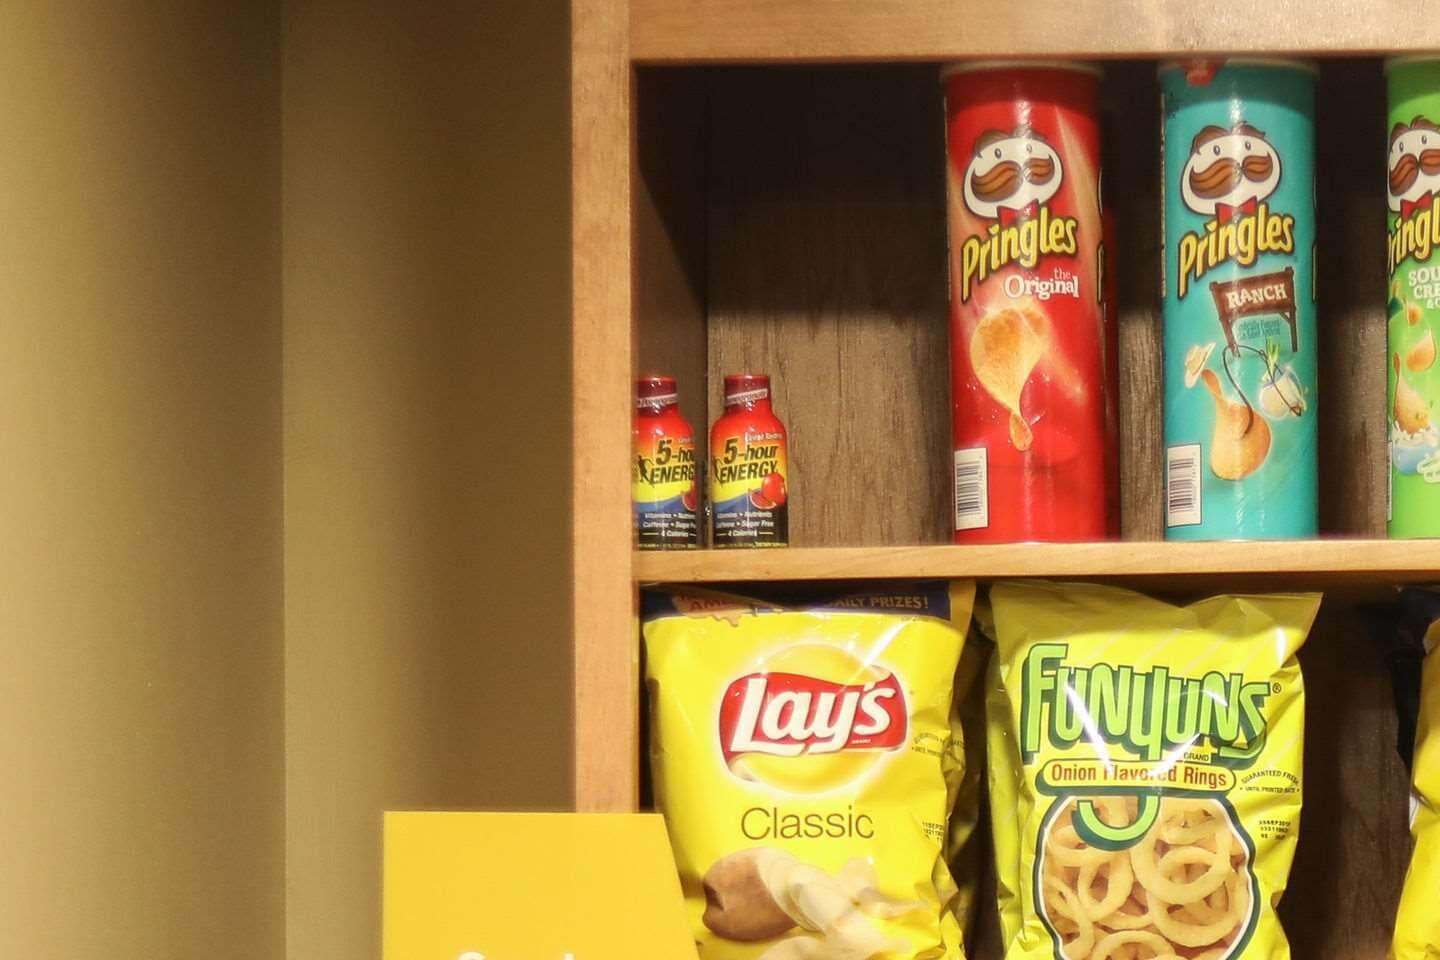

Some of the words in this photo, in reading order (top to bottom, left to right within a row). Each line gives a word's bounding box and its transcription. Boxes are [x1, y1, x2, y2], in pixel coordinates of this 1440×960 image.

[962, 207, 1077, 303] Pringles
[1178, 204, 1296, 300] Pringles
[1054, 267, 1071, 280] the
[1004, 275, 1079, 300] Original
[1226, 284, 1288, 309] RANCH
[724, 438, 779, 465] 5-hour
[720, 460, 778, 484] ENERGY
[869, 596, 929, 609] PRIZES!
[730, 677, 896, 757] Lay's
[1051, 764, 1097, 781] Onion
[1184, 766, 1227, 789] Rings
[741, 805, 875, 840] Classic
